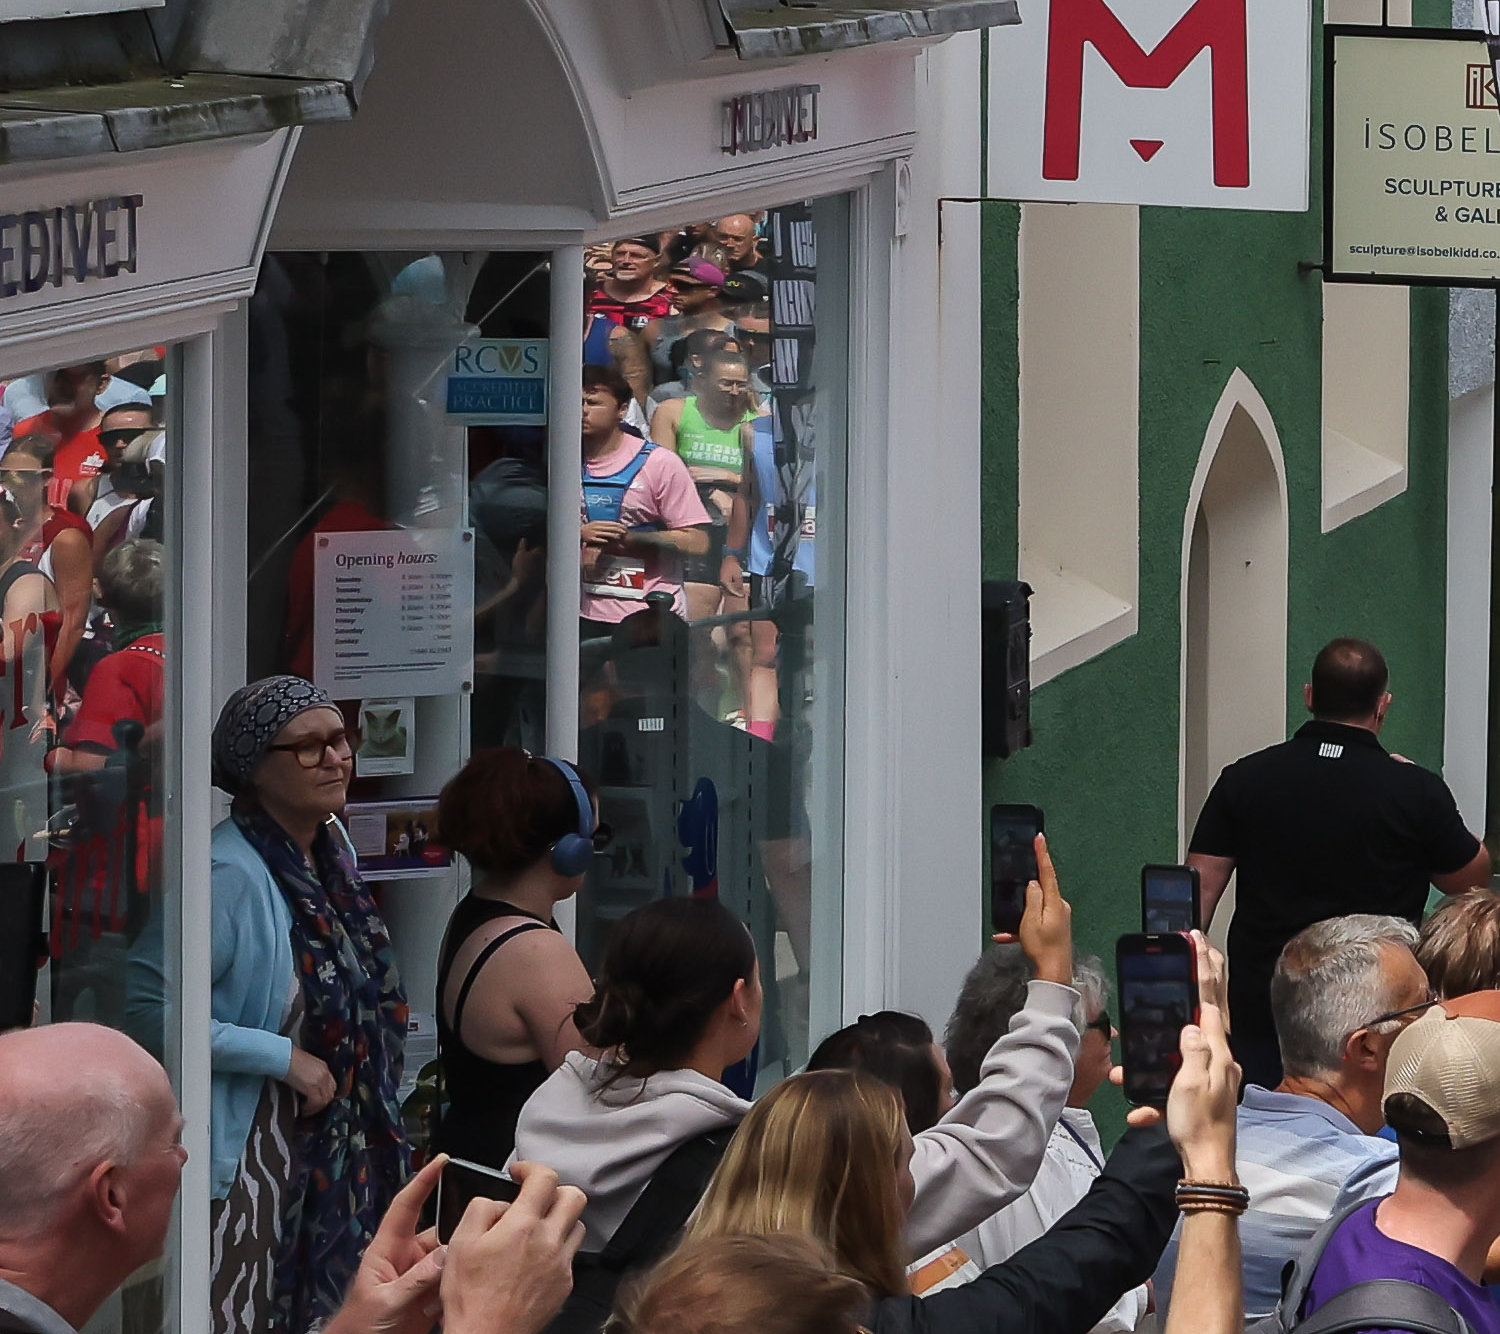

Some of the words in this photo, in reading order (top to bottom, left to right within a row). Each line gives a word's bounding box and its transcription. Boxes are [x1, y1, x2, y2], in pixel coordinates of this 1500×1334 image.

[1435, 206, 1448, 222] &
[0, 194, 143, 299] EDIVET
[452, 394, 538, 410] PRACTICE
[335, 553, 395, 569] Opening
[397, 551, 438, 566] hours:
